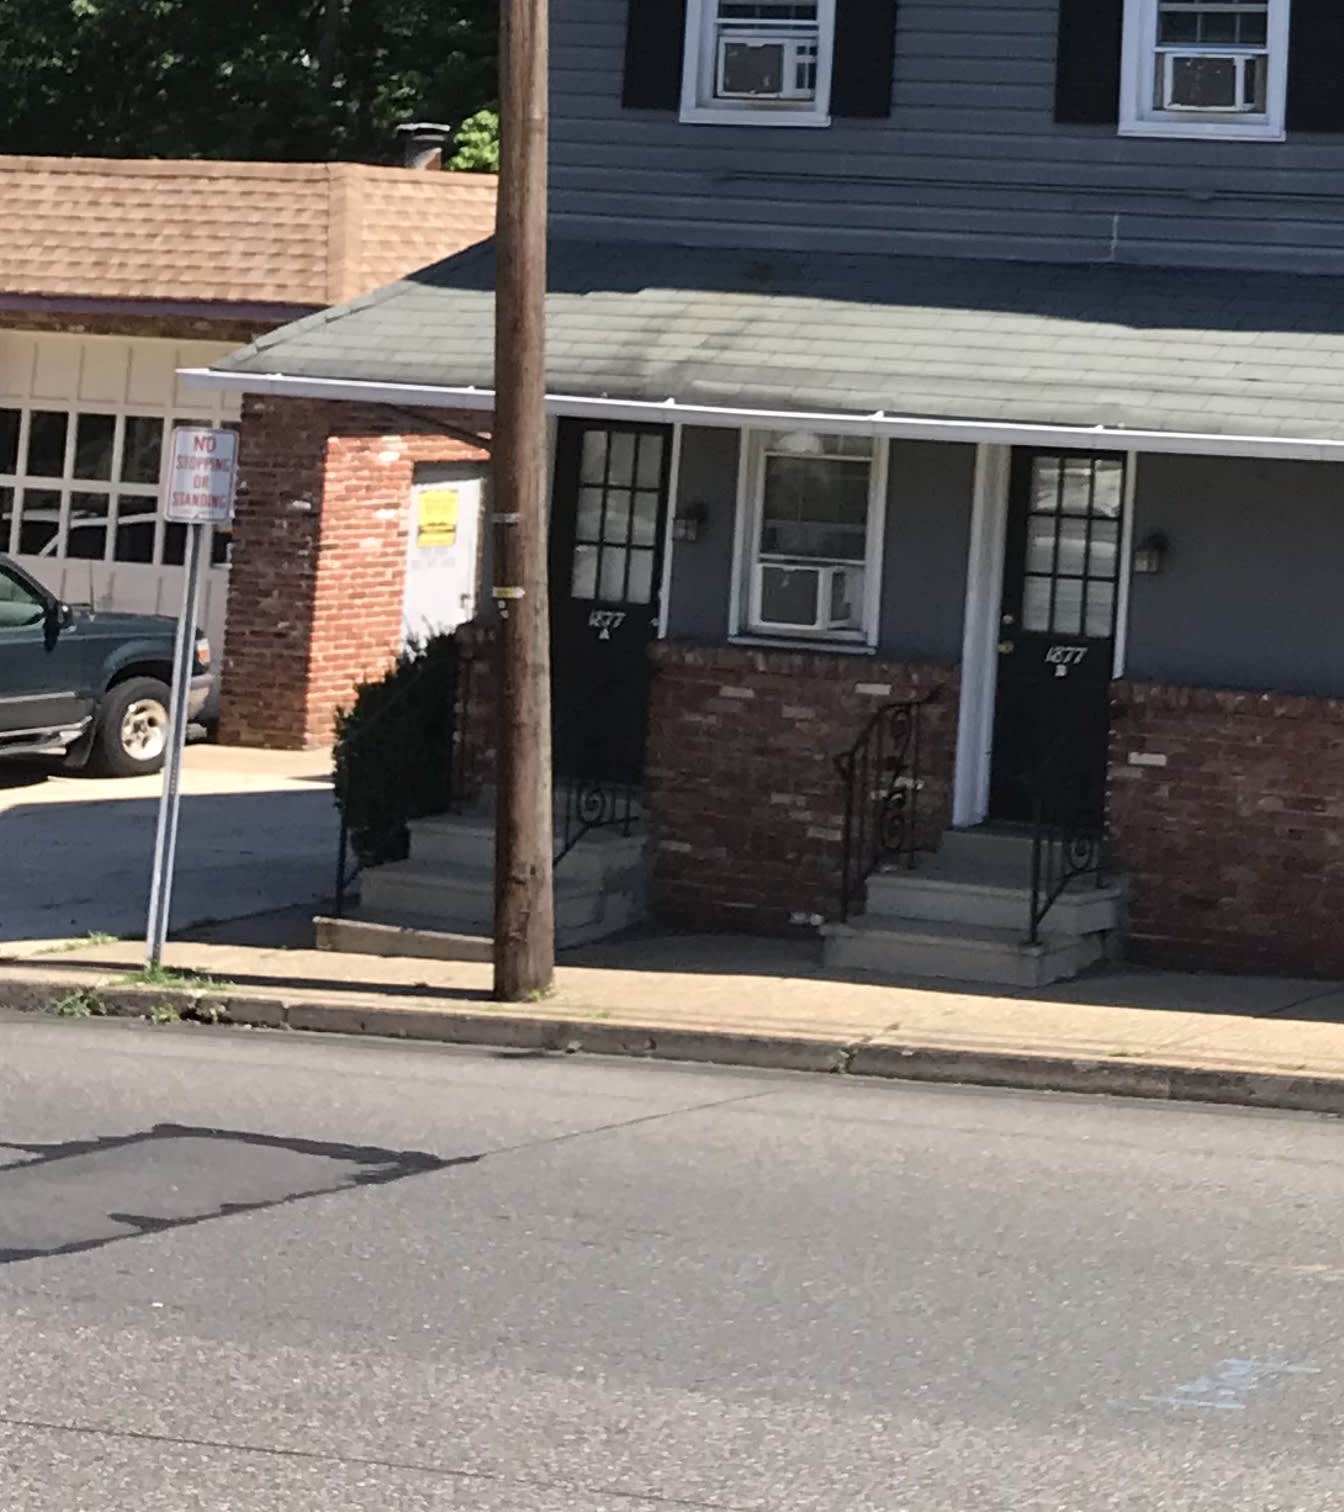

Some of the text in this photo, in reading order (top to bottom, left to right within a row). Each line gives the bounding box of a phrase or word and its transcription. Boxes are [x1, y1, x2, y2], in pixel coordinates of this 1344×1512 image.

[193, 435, 217, 453] NO
[192, 474, 210, 490] OR
[172, 491, 229, 509] STANDING
[1044, 645, 1089, 665] 1877
